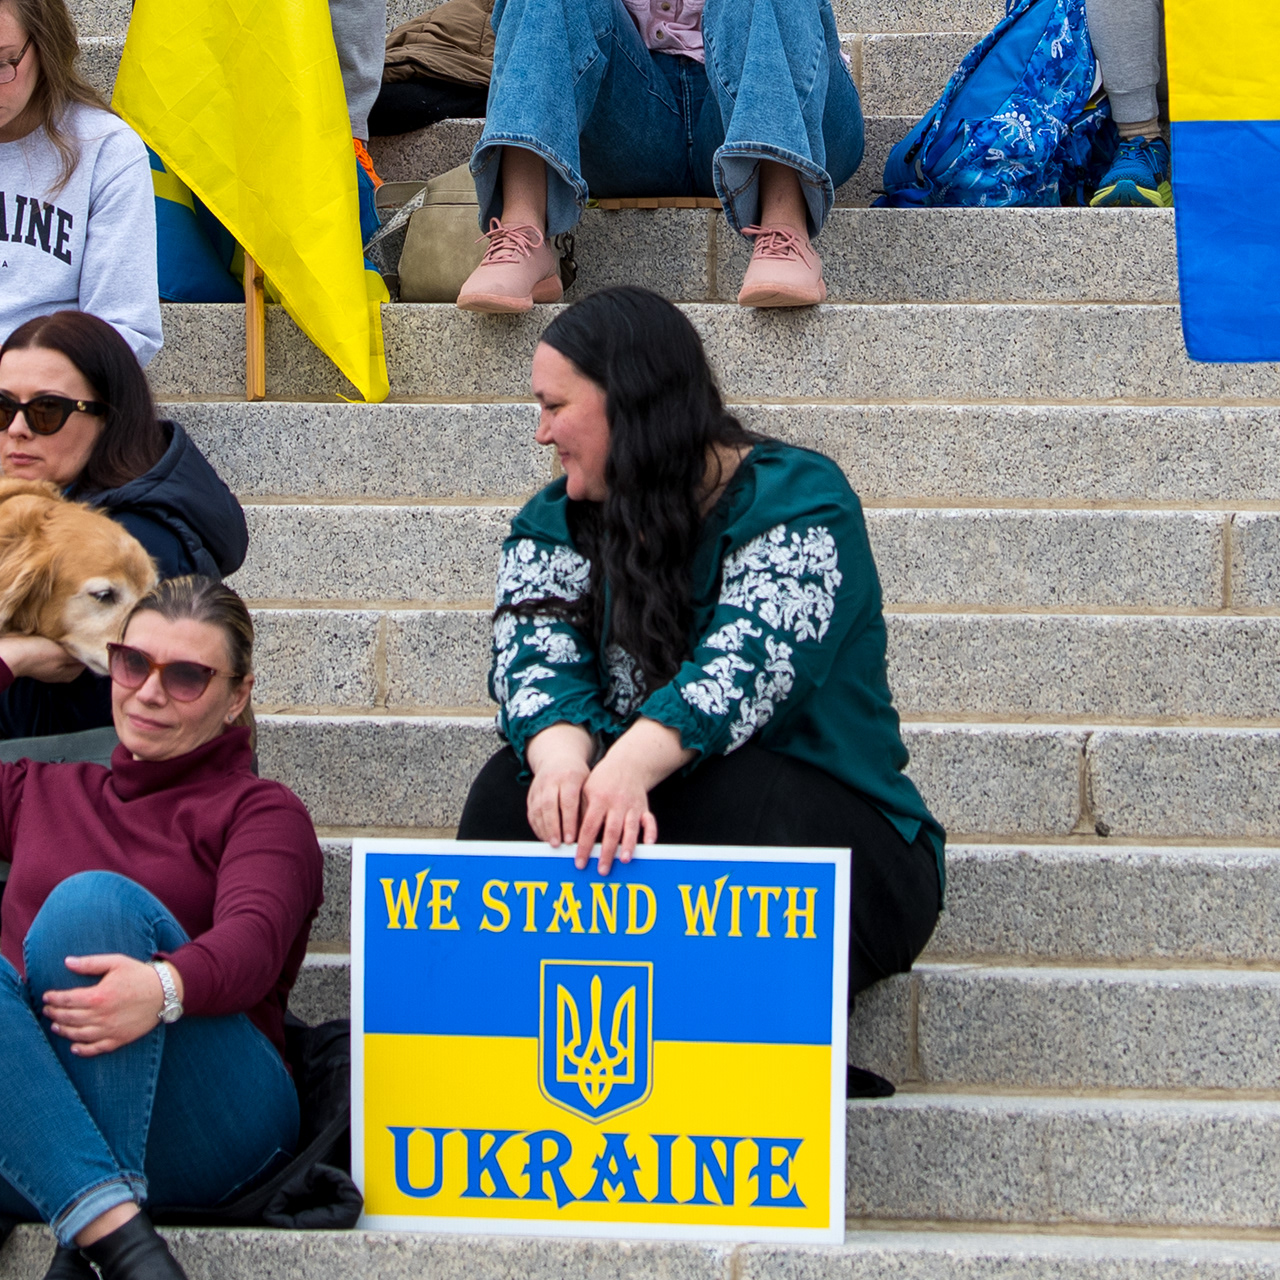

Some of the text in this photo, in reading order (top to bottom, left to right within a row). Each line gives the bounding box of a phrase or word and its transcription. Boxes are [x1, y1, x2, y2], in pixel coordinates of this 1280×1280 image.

[379, 867, 818, 939] WE STAND WITH
[385, 1125, 809, 1211] UKRAINE
